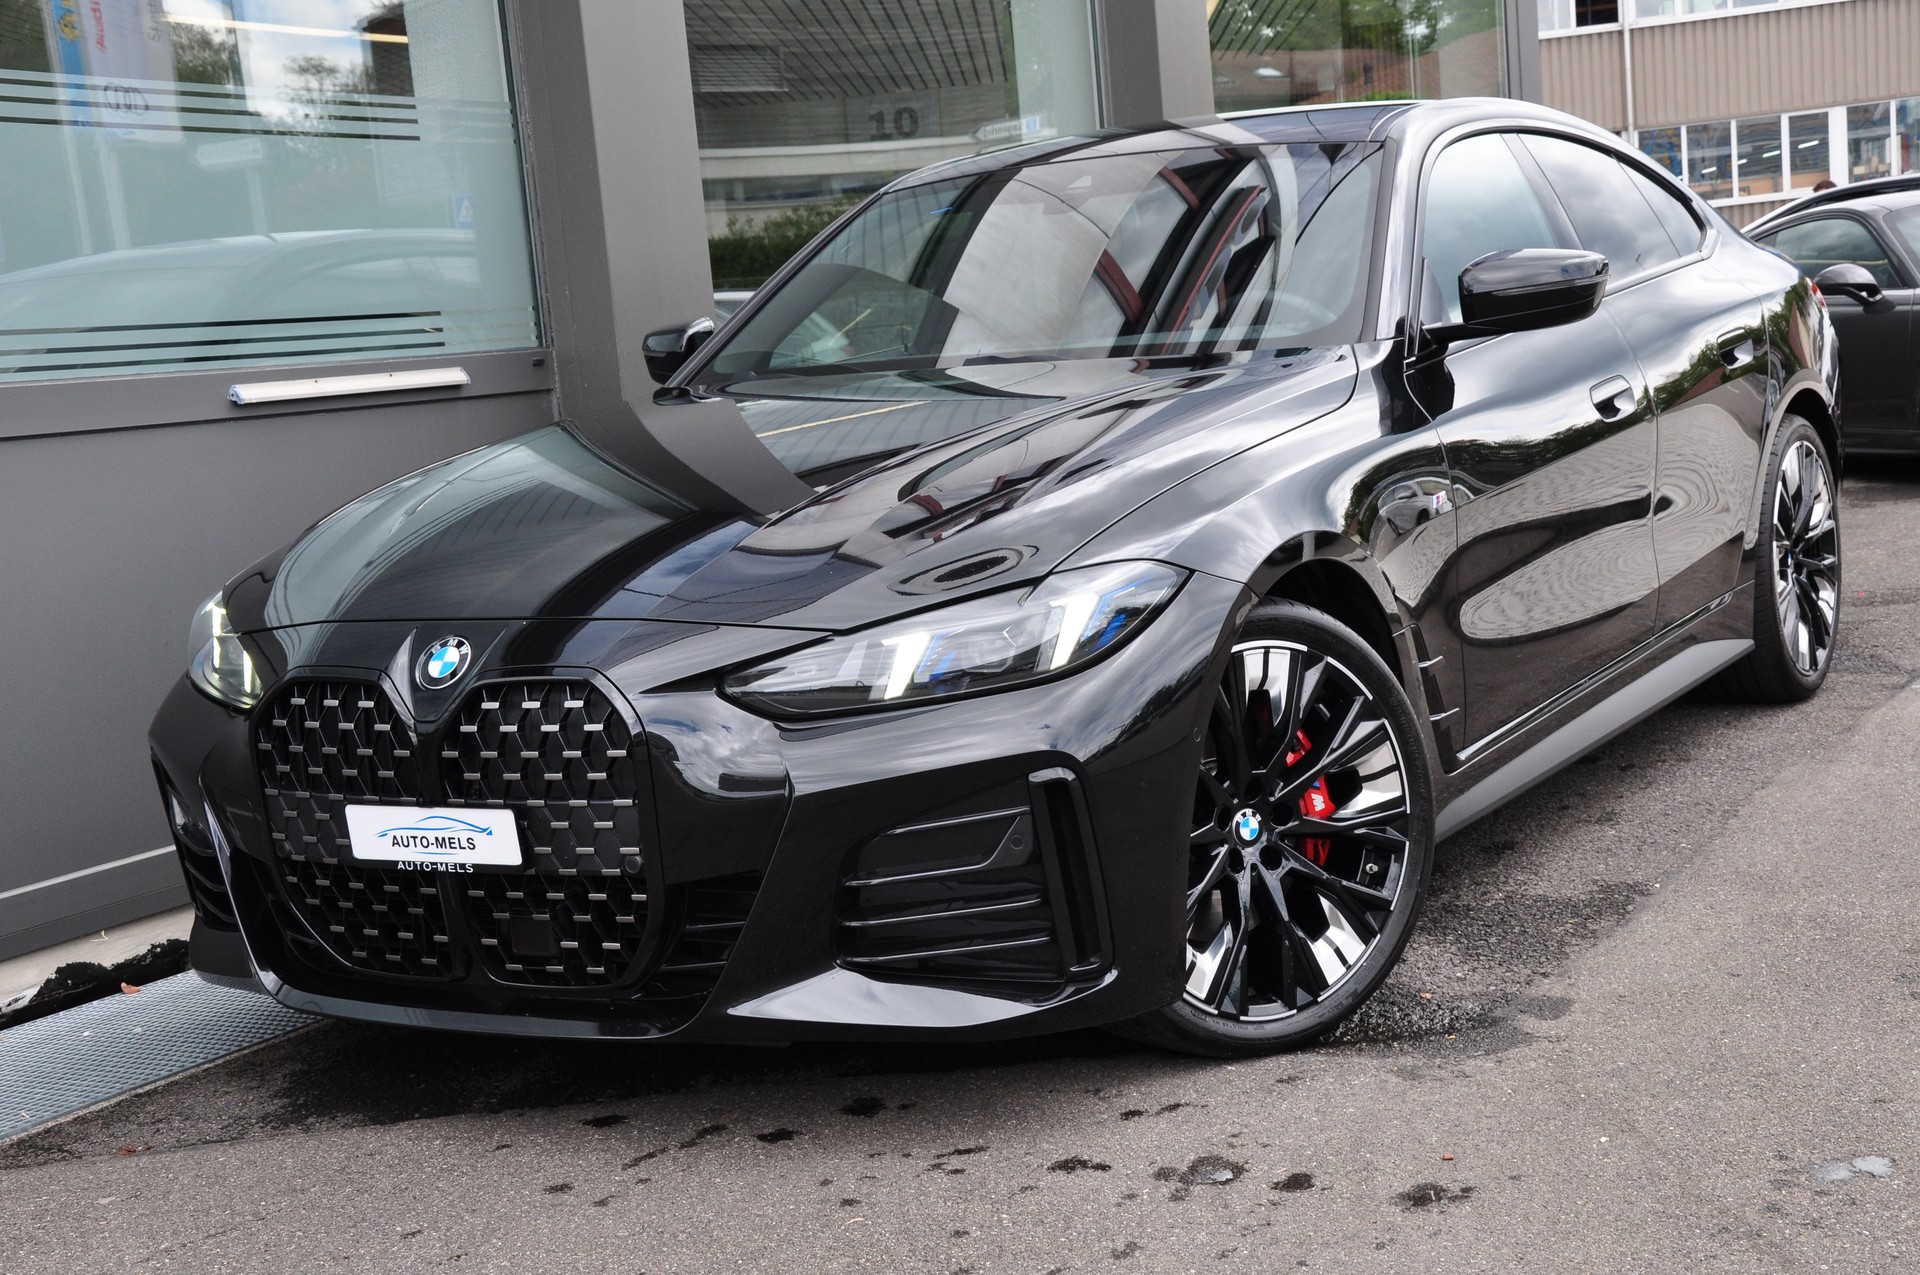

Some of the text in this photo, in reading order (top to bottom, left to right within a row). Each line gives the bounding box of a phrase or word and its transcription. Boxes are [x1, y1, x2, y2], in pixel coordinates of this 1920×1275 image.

[868, 107, 919, 141] 10
[431, 639, 469, 655] BMW
[392, 834, 476, 850] AUTO-MELS
[397, 860, 474, 873] AUTO-MELS
